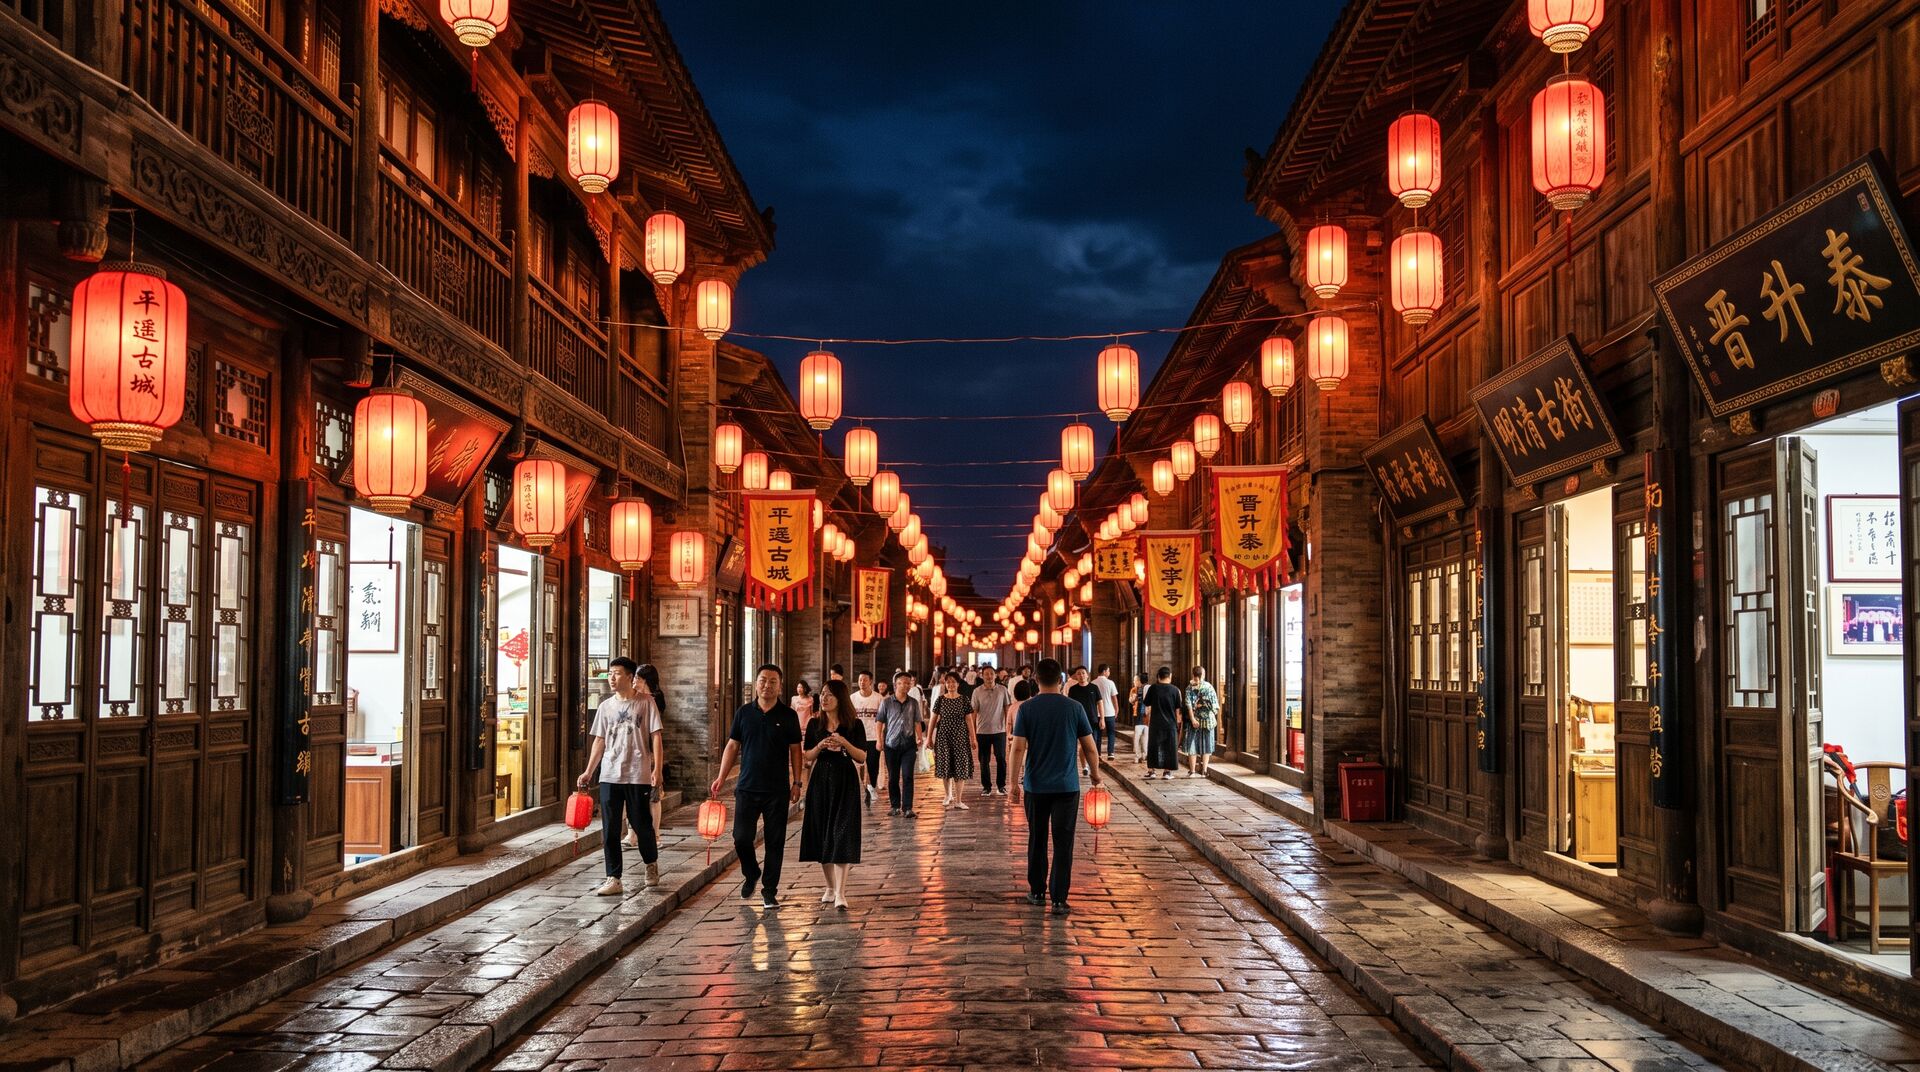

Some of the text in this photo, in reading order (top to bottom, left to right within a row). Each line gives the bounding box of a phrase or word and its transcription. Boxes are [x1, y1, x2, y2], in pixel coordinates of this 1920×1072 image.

[130, 290, 160, 400] 平遥古城
[1704, 228, 1893, 370] 晋升泰
[767, 507, 793, 581] 平遥古城
[1236, 494, 1263, 551] 晋升泰
